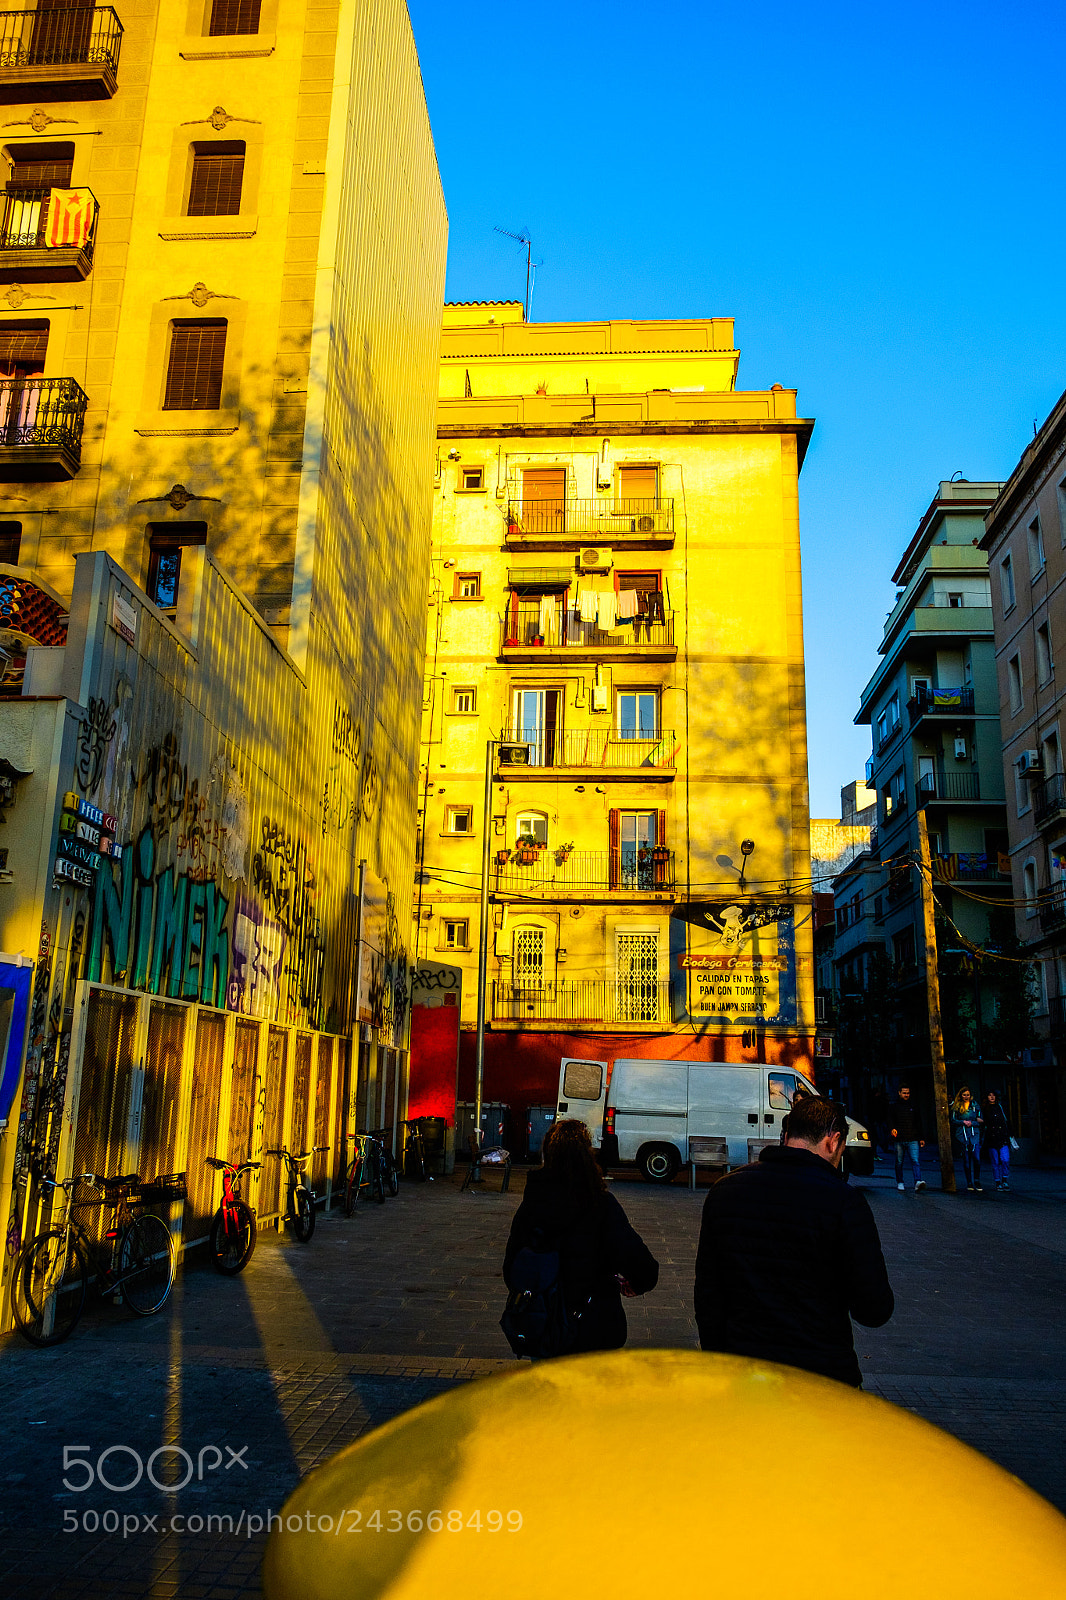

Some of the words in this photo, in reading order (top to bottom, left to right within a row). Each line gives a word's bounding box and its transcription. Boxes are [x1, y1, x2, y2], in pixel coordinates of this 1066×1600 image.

[682, 956, 722, 970] Bodega
[696, 974, 730, 983] CALIDAD
[733, 975, 741, 983] EN
[744, 975, 770, 984] TAPAS
[700, 985, 715, 996] PAN
[717, 985, 732, 996] CON
[736, 986, 767, 996] TOMATE
[700, 1002, 715, 1012] BUEN
